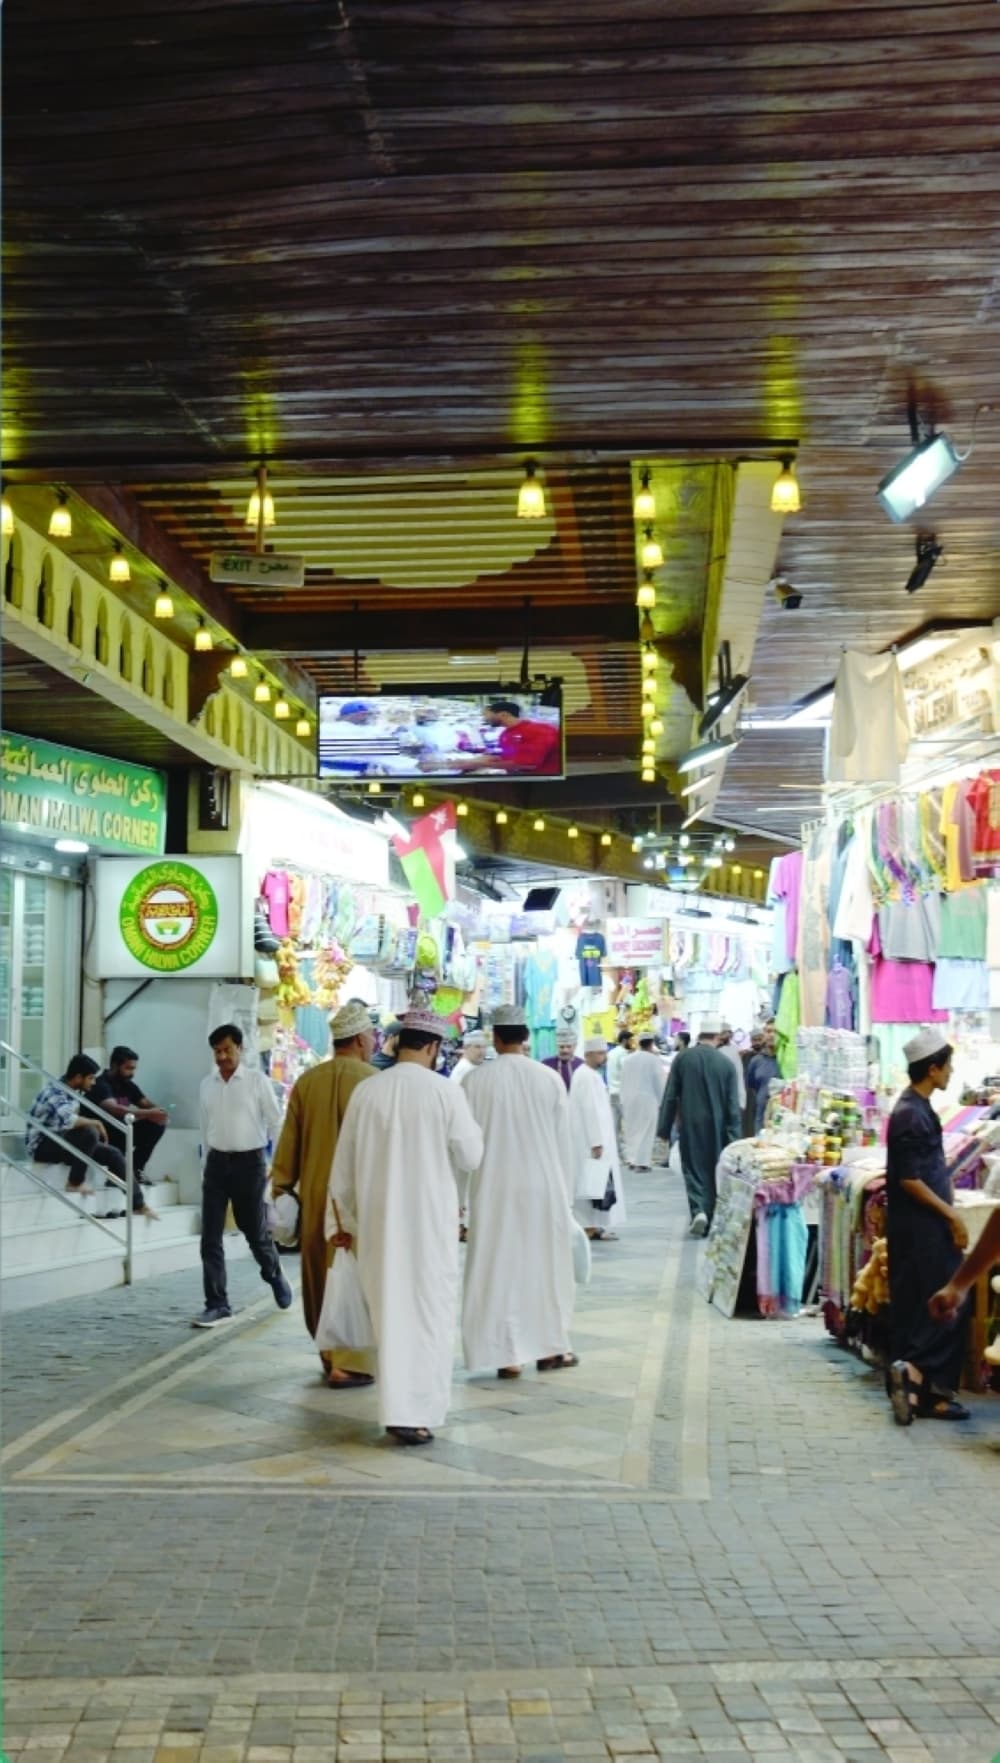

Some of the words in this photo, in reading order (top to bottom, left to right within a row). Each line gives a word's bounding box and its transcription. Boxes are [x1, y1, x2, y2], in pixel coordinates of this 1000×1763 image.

[223, 558, 253, 572] EXIT
[73, 764, 128, 798] الحلوى
[130, 778, 158, 812] ركن
[49, 799, 99, 837] HALWA
[102, 810, 158, 848] CORNER
[121, 917, 145, 957] OMAN
[141, 950, 181, 969] HALWA
[179, 915, 217, 964] CORNER
